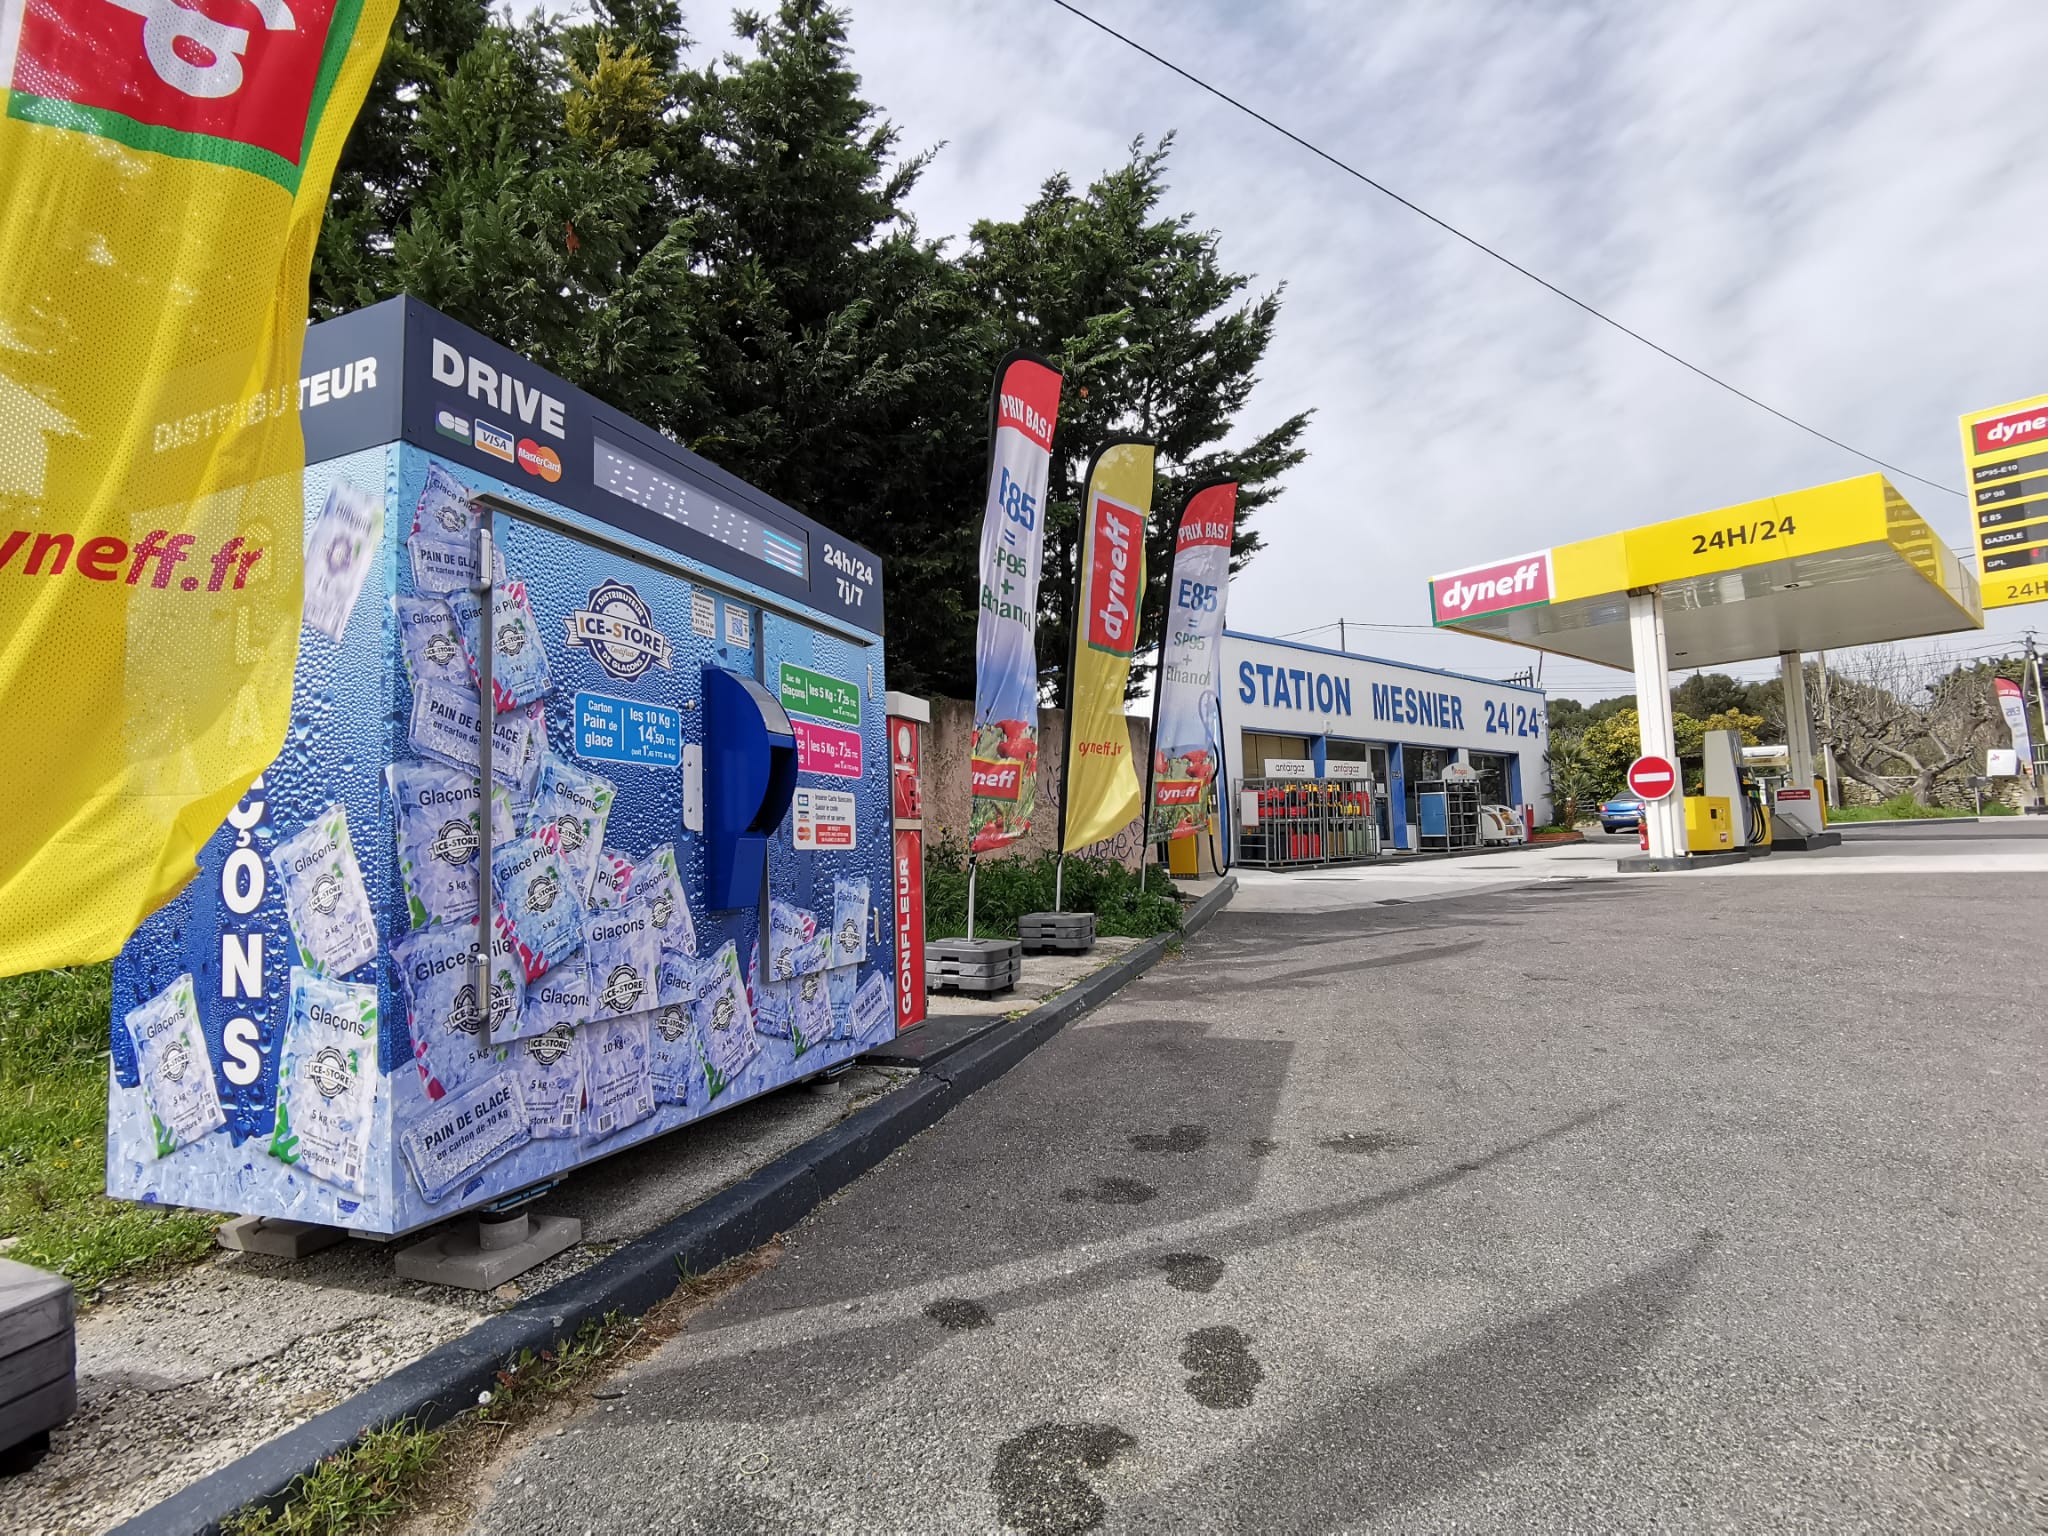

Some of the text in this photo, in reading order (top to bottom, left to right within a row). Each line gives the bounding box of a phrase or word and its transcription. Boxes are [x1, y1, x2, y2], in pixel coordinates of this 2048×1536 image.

[432, 337, 566, 440] DRIVE
[1000, 393, 1025, 421] PRIX
[482, 432, 507, 450] VISA
[517, 447, 562, 473] MasterCard
[1976, 464, 2018, 479] SP95-E10
[432, 479, 457, 501] Glace
[1979, 491, 1992, 502] SP
[1981, 512, 2002, 524] E 85
[1178, 522, 1229, 544] PRIX BAS!
[1690, 515, 1797, 555] 24H/24
[1984, 532, 2024, 545] GAZOLE
[421, 549, 456, 565] PAIN DE
[822, 543, 875, 586] 24h/24
[996, 545, 1027, 577] P95
[1987, 560, 2007, 569] GPL
[1099, 512, 1130, 641] dyneff
[835, 577, 864, 606] 7j/7
[1178, 579, 1218, 613] E85
[1441, 562, 1540, 613] dyneff
[599, 590, 645, 618] DISTRIBUTEUR
[412, 611, 453, 625] Glaçons
[579, 616, 662, 653] ICE-STORE
[1174, 631, 1206, 651] SP95
[601, 652, 644, 675] DE GLAÇONS
[1166, 665, 1211, 686] Ethanol
[781, 683, 806, 699] Glaçons
[809, 684, 819, 697] les
[819, 688, 824, 698] 5
[1238, 660, 1352, 717] STATION
[1372, 682, 1465, 731] MESNIER
[430, 700, 457, 722] PAIN
[458, 713, 472, 728] DE
[588, 700, 613, 714] Carton
[583, 713, 618, 732] Pain de
[630, 707, 643, 722] les
[645, 710, 657, 724] 10
[658, 712, 671, 729] Kg
[433, 720, 443, 731] en
[443, 725, 468, 742] carton
[585, 731, 614, 748] glace
[666, 737, 676, 747] TTC
[810, 741, 821, 753] les
[821, 743, 825, 753] 5
[971, 770, 1016, 789] neff
[1275, 763, 1306, 775] antargaz
[1333, 764, 1360, 775] antargaz
[419, 787, 481, 806] Glaçons
[555, 782, 598, 812] Glaçons
[1158, 786, 1198, 799] dyneff
[434, 836, 479, 854] ICE-STORE
[558, 828, 584, 844] E-STORE
[294, 839, 338, 873] Glaçons
[500, 858, 532, 881] Glace
[448, 880, 467, 893] 5 kg
[634, 869, 668, 896] Glaçons
[311, 883, 342, 906] ICE-STORE
[527, 884, 557, 908] ICE-STORE
[324, 927, 331, 938] 5
[542, 923, 548, 932] 5
[592, 917, 645, 943] Glaçons
[772, 917, 793, 936] Glace
[899, 857, 910, 1015] GONFLEUR
[415, 951, 468, 981] Glace
[802, 951, 827, 971] Glaçons
[603, 980, 644, 1001] ICE-STORE
[699, 967, 732, 999] Glaçons
[147, 1008, 186, 1039] Glaçons
[310, 1004, 365, 1037] Glaçons
[530, 1040, 569, 1049] ICE-STORE
[603, 1038, 624, 1054] 10 kg
[161, 1052, 189, 1072] ICE-STORE
[469, 1048, 490, 1063] 5 kg
[656, 1051, 661, 1060] 5
[311, 1064, 351, 1087] ICE-STORE
[531, 1079, 548, 1092] 5 kg
[311, 1109, 317, 1121] 5
[424, 1122, 454, 1151] PAIN
[456, 1113, 473, 1130] DE
[474, 1086, 512, 1118] GLACE
[436, 1108, 509, 1161] en carton de 10 Kg
